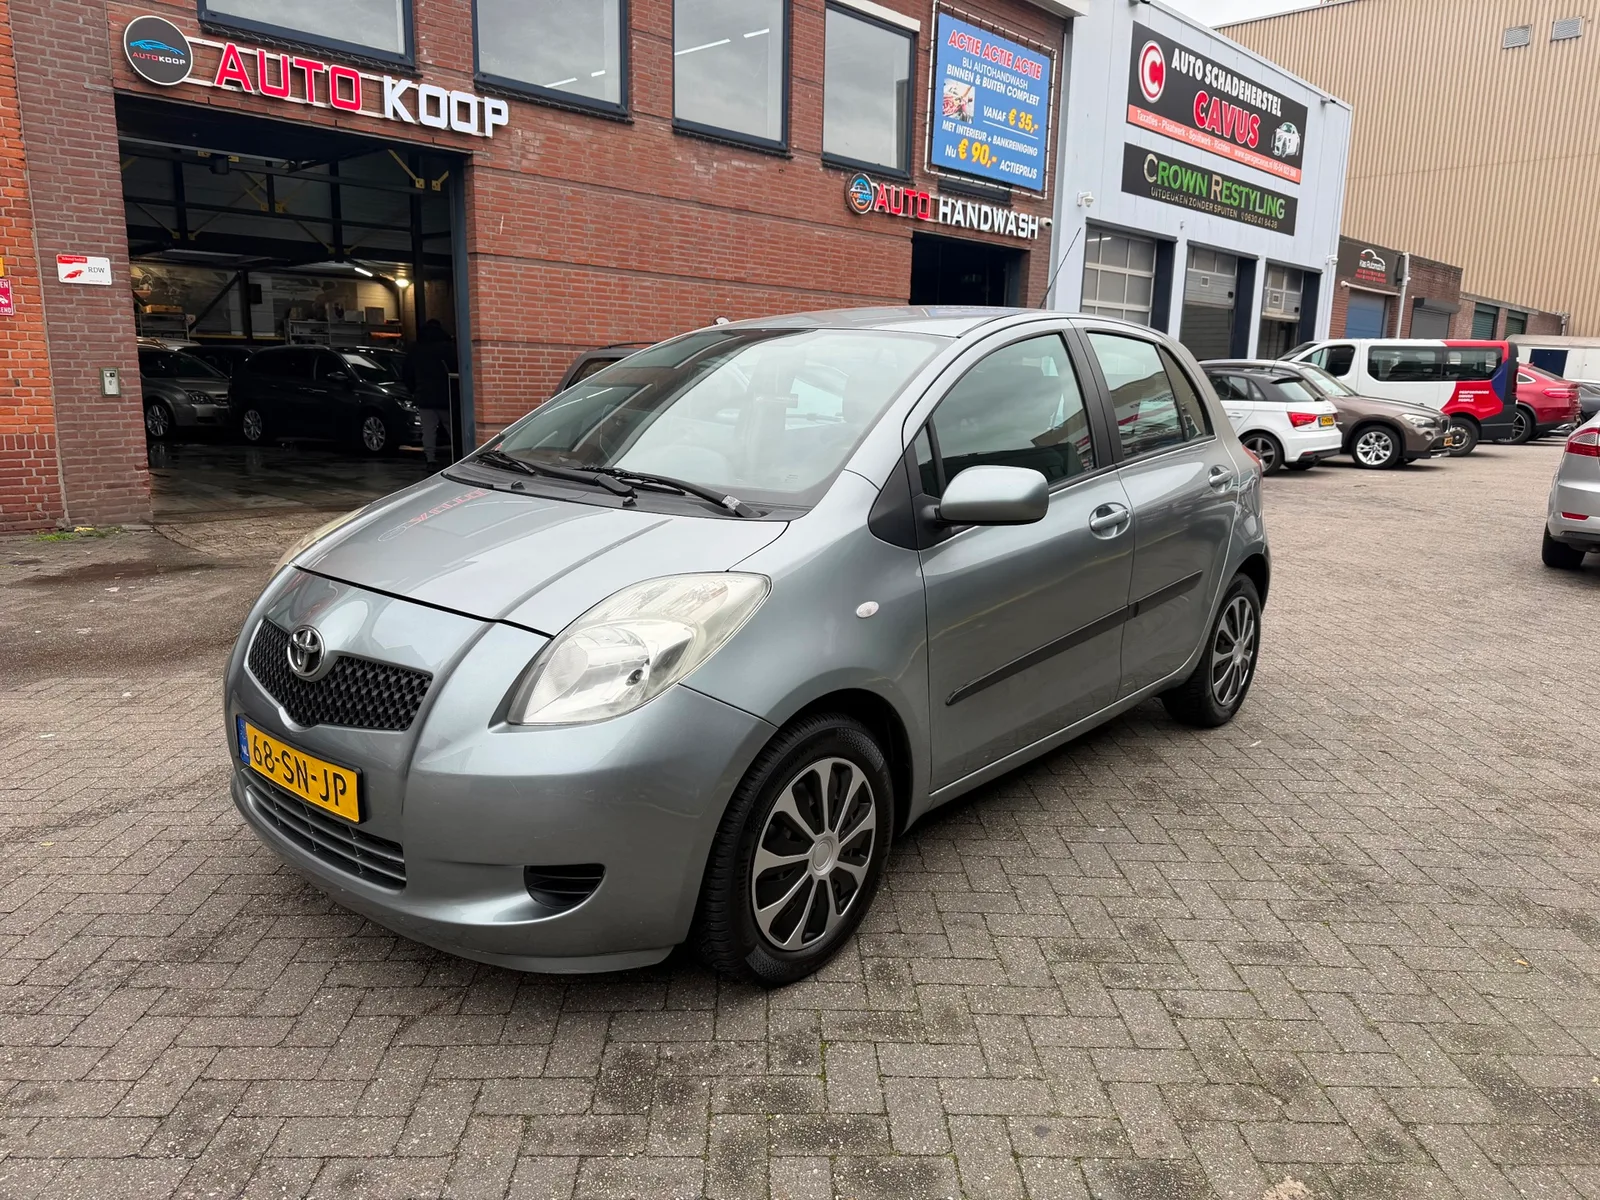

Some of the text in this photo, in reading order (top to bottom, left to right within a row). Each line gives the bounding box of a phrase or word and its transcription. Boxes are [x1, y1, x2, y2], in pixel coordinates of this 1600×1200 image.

[132, 52, 186, 65] AUTOKOOP
[948, 29, 1042, 80] ACTIE ACTIE ACTIE
[962, 57, 1028, 90] BIJ AUTOHANDWASH
[214, 42, 509, 138] AUTO KOOP
[946, 64, 1040, 106] BINNEN & BUITEN COMPLEET
[1171, 48, 1282, 117] AUTO SCHADEHERSTEL
[983, 105, 1007, 122] VANAF
[1193, 90, 1260, 149] CAVUS
[942, 120, 955, 132] MET
[956, 125, 987, 142] INTERIEUR
[992, 136, 1038, 157] BANKREINIGING
[999, 159, 1038, 180] ACTIEPRIJS
[1143, 153, 1286, 220] CROWN RESTYLING
[873, 183, 1039, 240] AUTO HANDWASH
[1150, 186, 1188, 205] UITDEUKEN
[1188, 197, 1213, 211] ZONDER
[1213, 204, 1238, 218] SPUITEN
[0, 281, 9, 289] EN
[87, 266, 105, 274] RDW
[253, 734, 347, 807] 68-SN-JP
